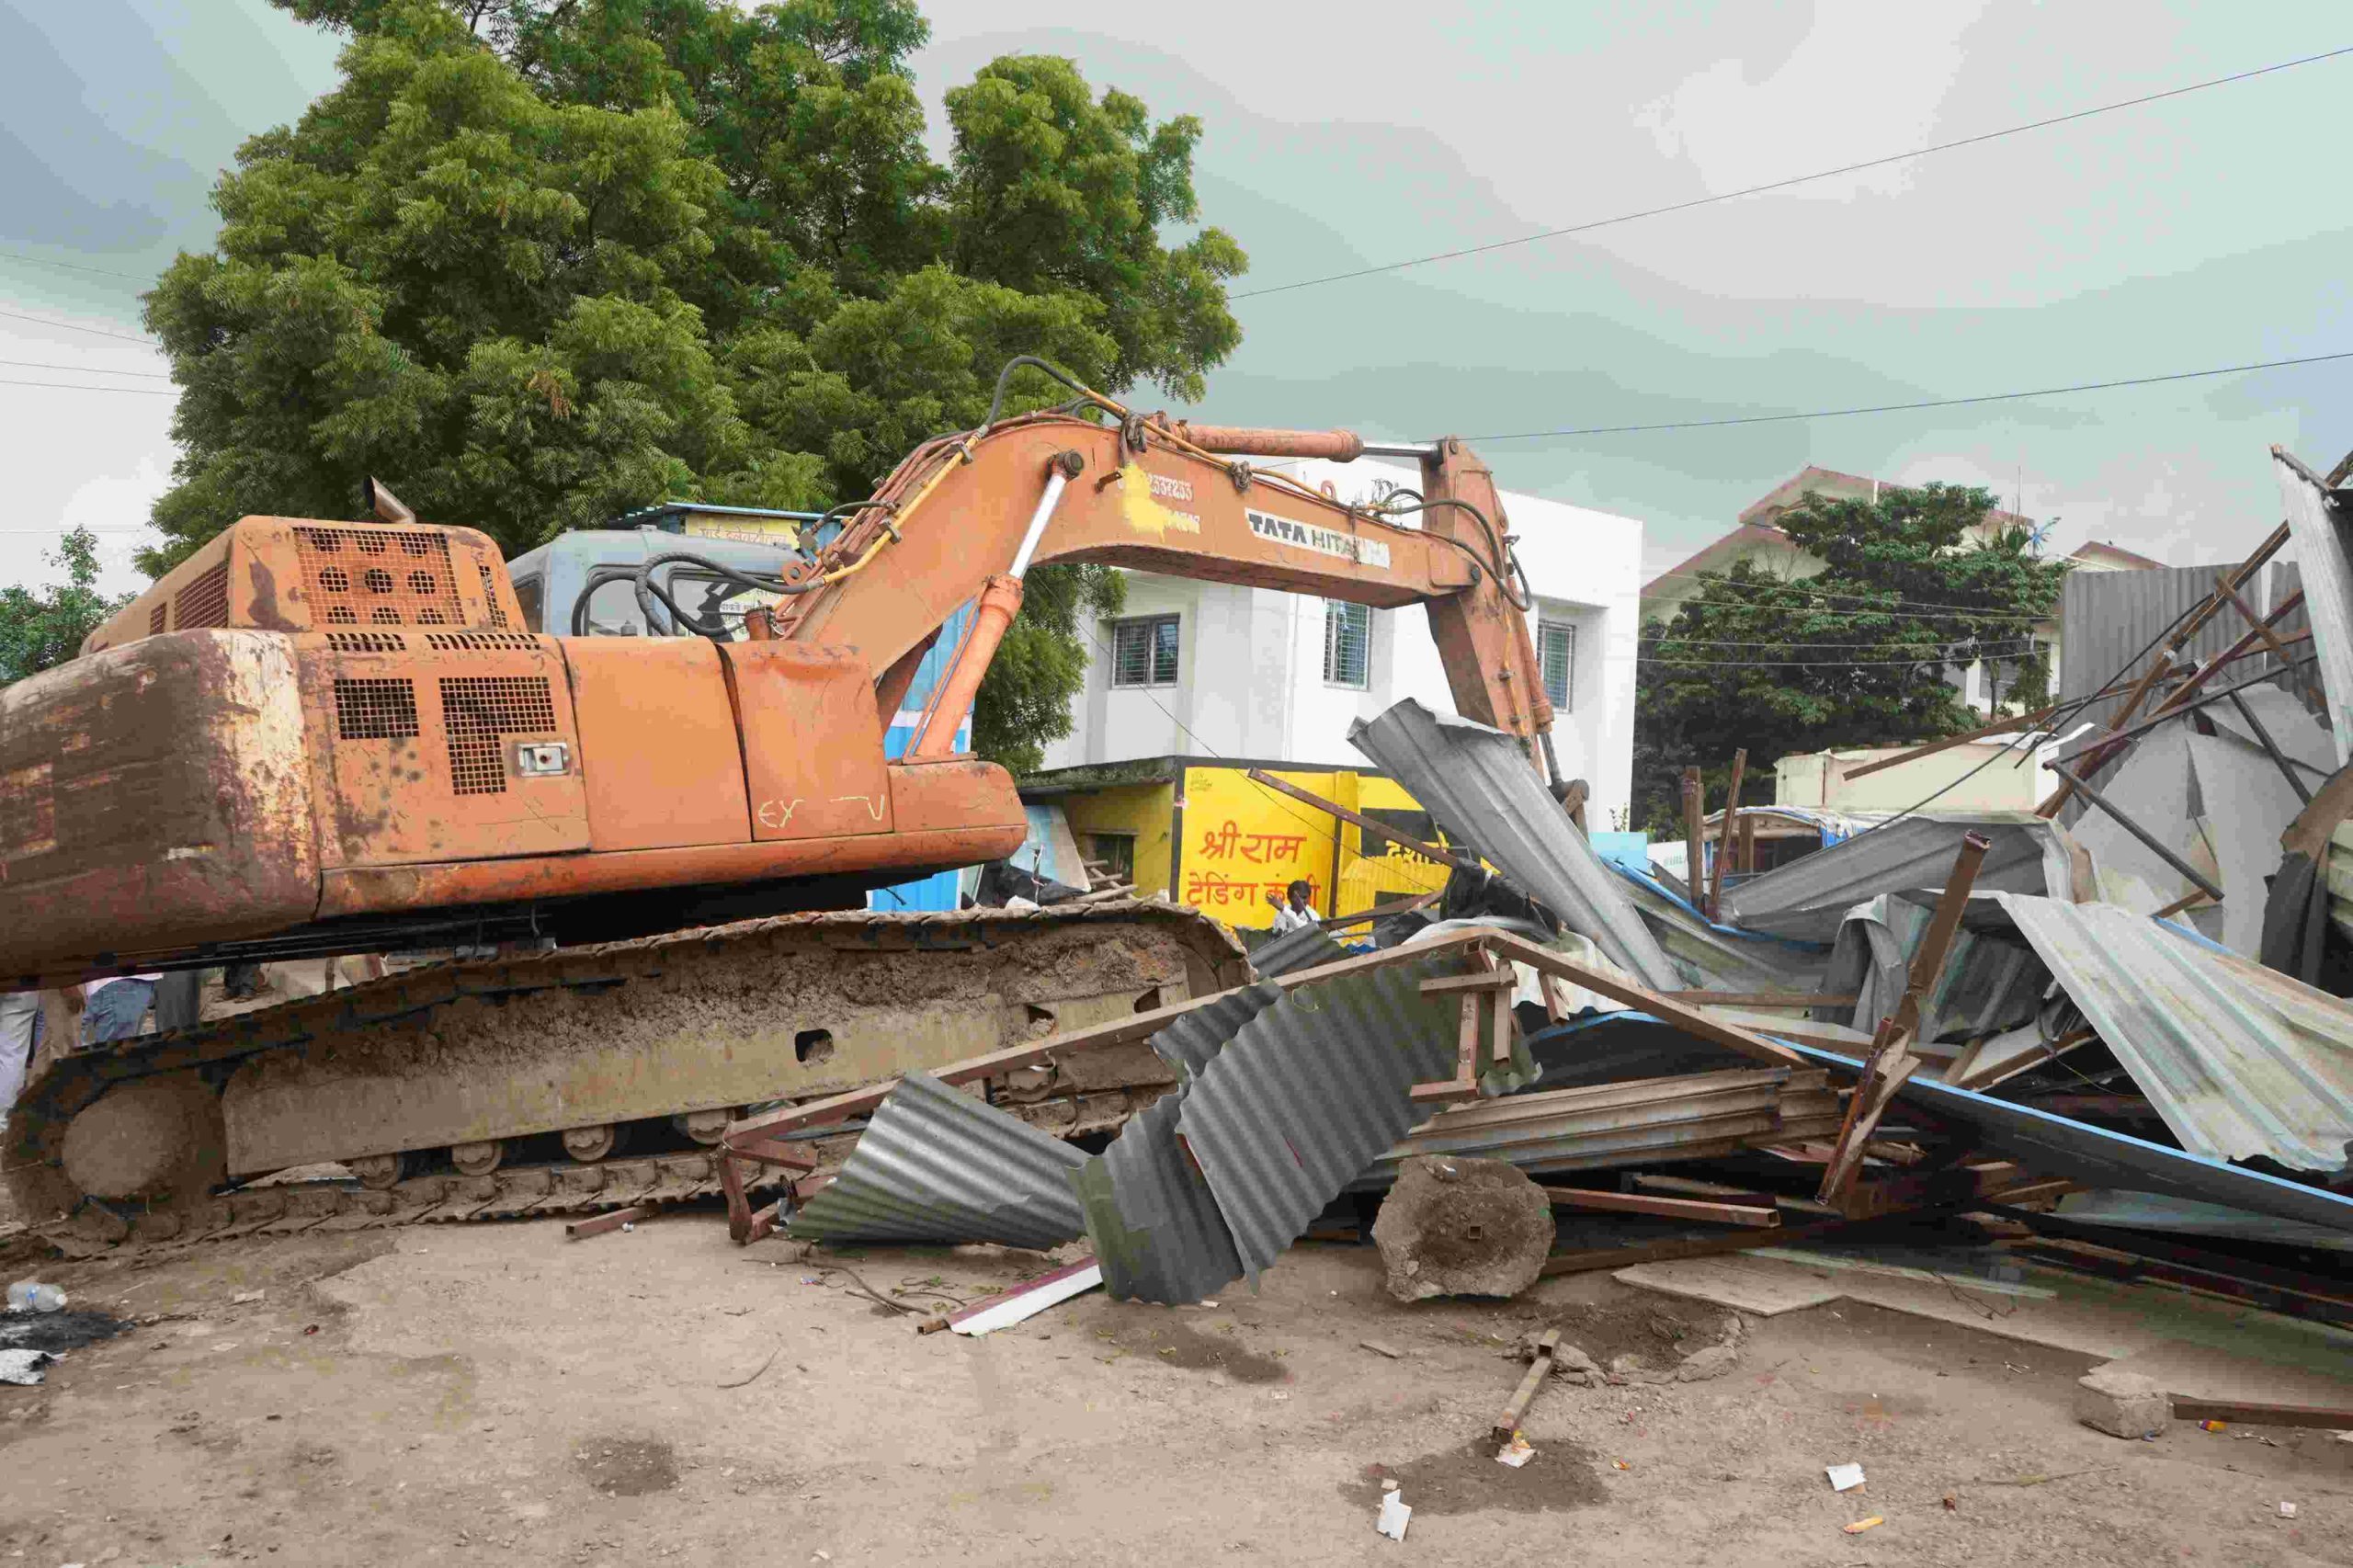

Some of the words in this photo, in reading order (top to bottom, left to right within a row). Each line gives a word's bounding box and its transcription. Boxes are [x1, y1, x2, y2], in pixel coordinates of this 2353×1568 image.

[1248, 513, 1307, 545] TATA
[1199, 820, 1242, 859] श्री
[1240, 834, 1307, 864] राम
